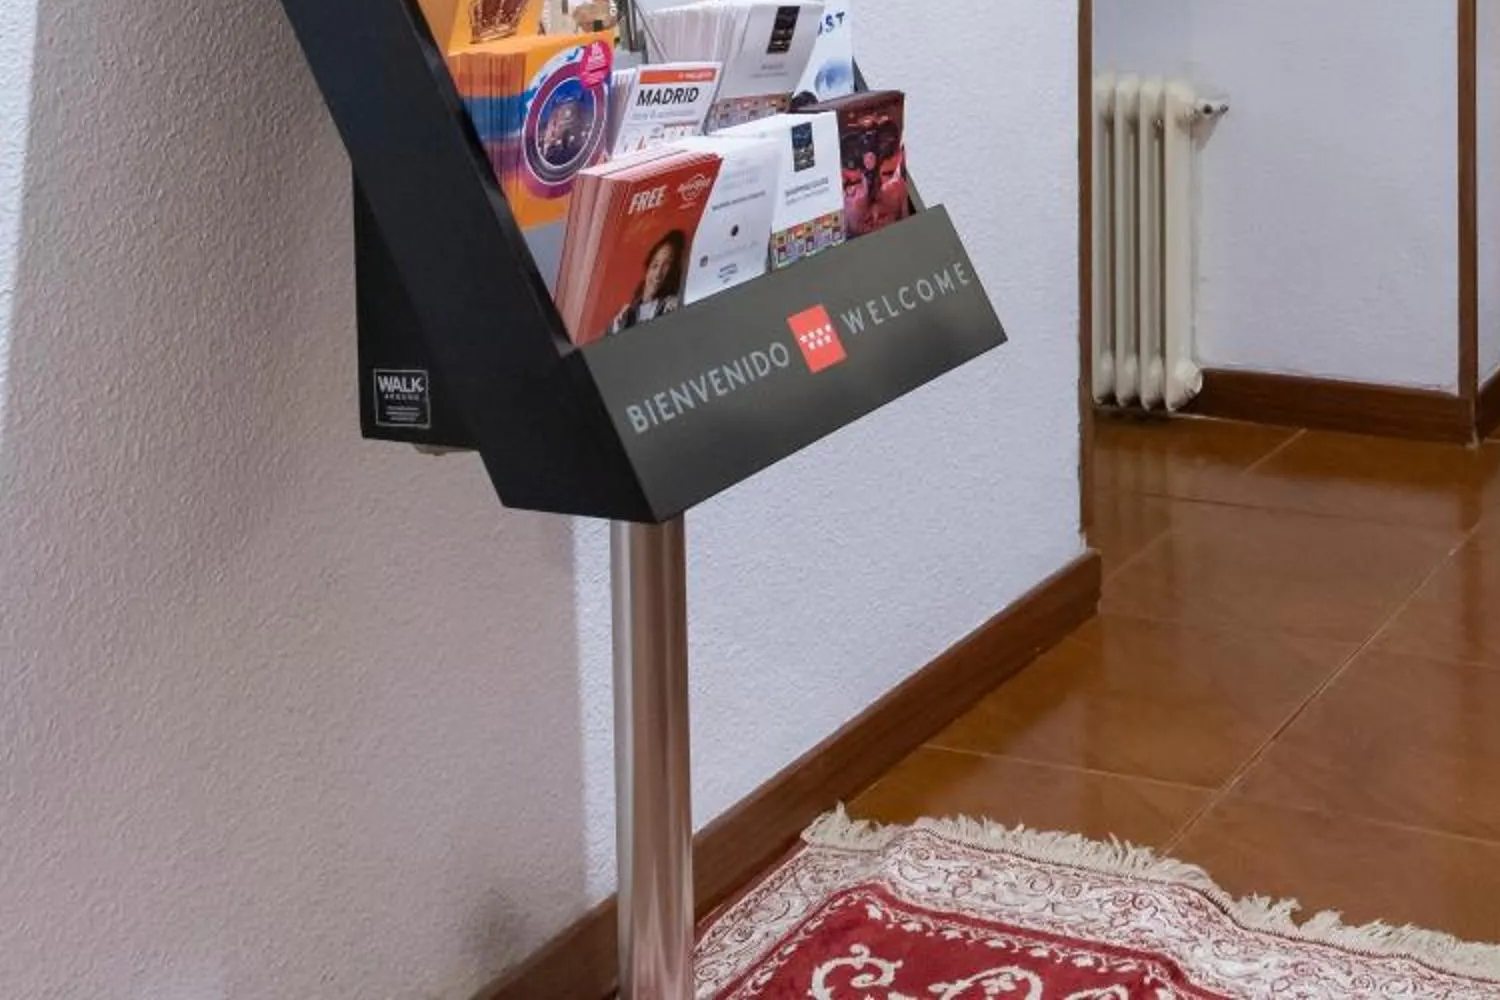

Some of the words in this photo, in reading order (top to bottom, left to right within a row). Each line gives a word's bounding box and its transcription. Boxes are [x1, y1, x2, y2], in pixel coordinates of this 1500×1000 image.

[636, 87, 700, 106] MADRID
[628, 185, 669, 215] FREE
[626, 341, 791, 435] BIENVENIDO
[841, 262, 973, 336] WELCOME
[377, 375, 425, 393] WALK
